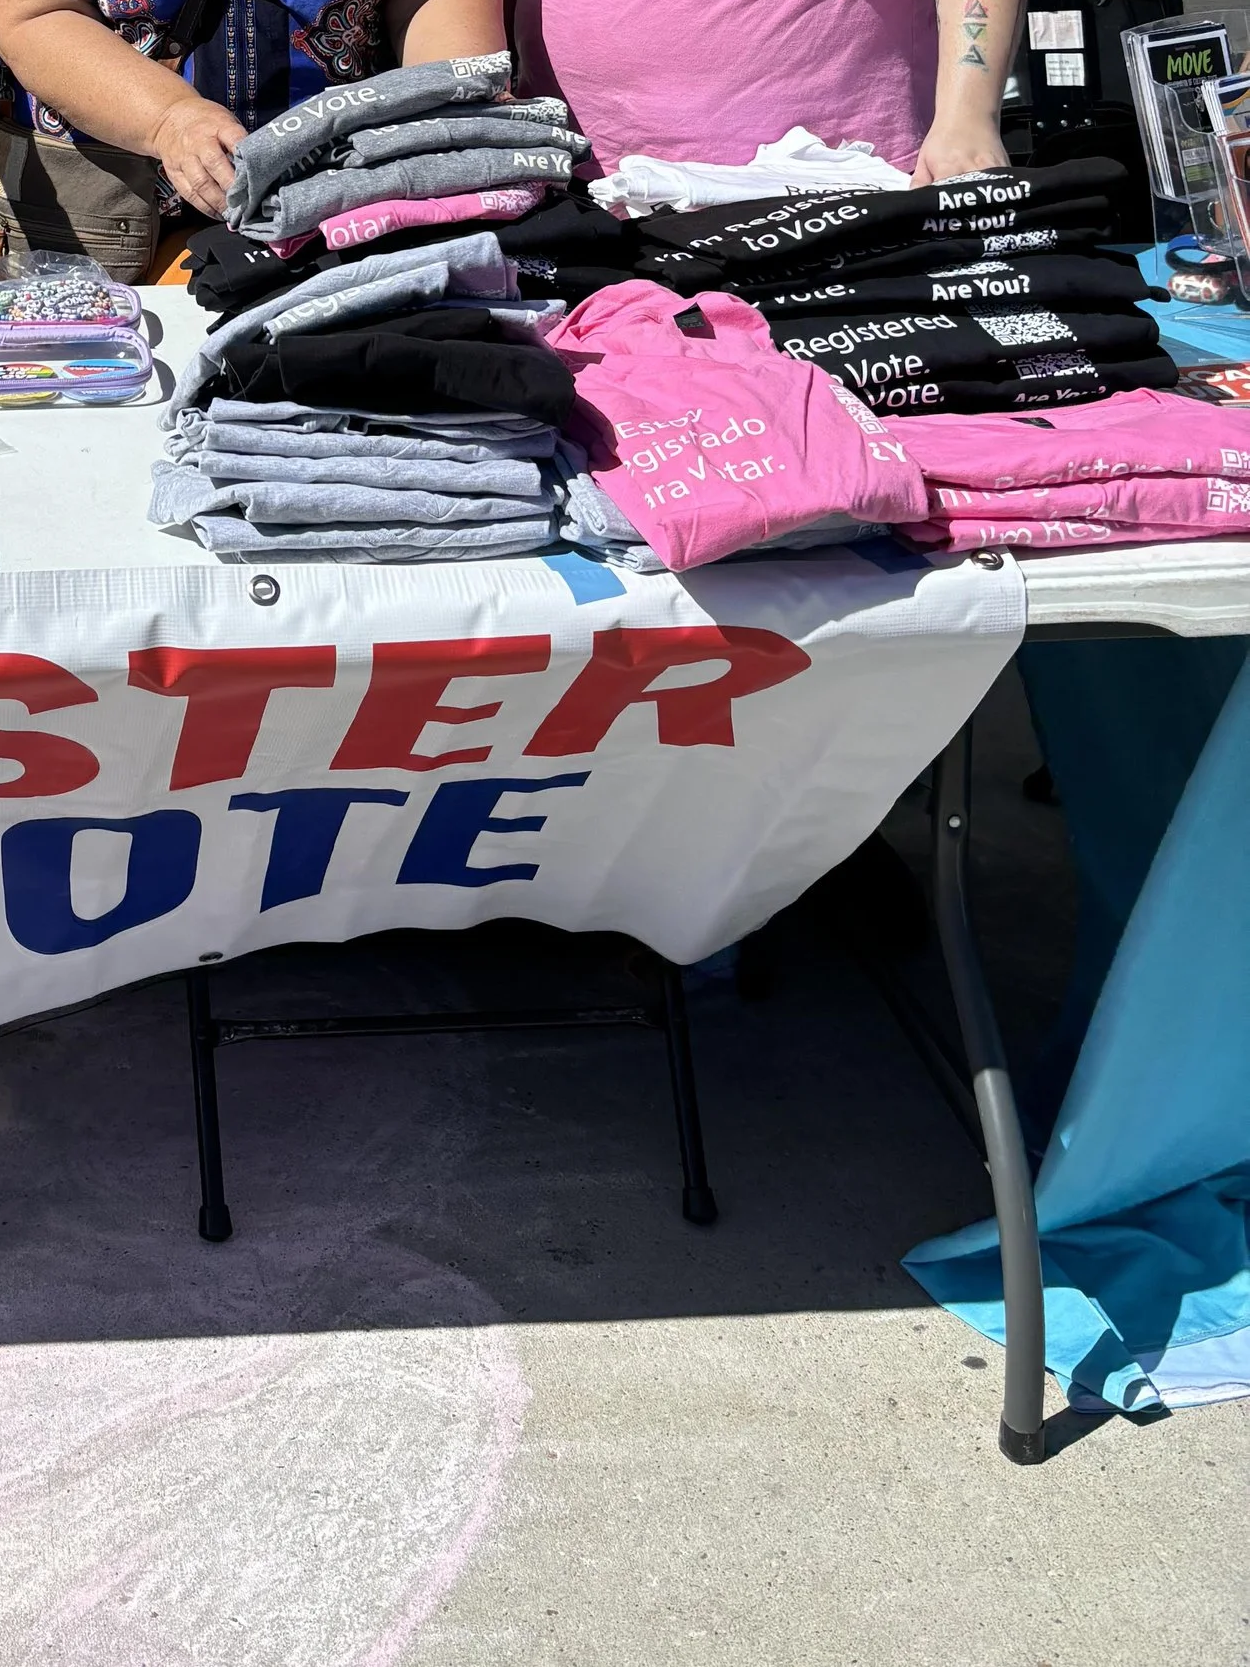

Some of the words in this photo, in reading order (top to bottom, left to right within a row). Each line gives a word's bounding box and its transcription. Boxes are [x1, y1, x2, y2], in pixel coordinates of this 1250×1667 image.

[1167, 48, 1214, 81] MOVE
[268, 116, 301, 138] to
[303, 85, 387, 121] Vote.
[513, 151, 548, 170] Are
[938, 187, 977, 211] Are
[981, 181, 1032, 205] You?
[741, 230, 776, 253] to
[786, 205, 869, 242] Vote.
[932, 281, 970, 301] Are
[974, 275, 1031, 298] You?
[784, 313, 958, 361] Registered
[846, 353, 931, 389] Vote.
